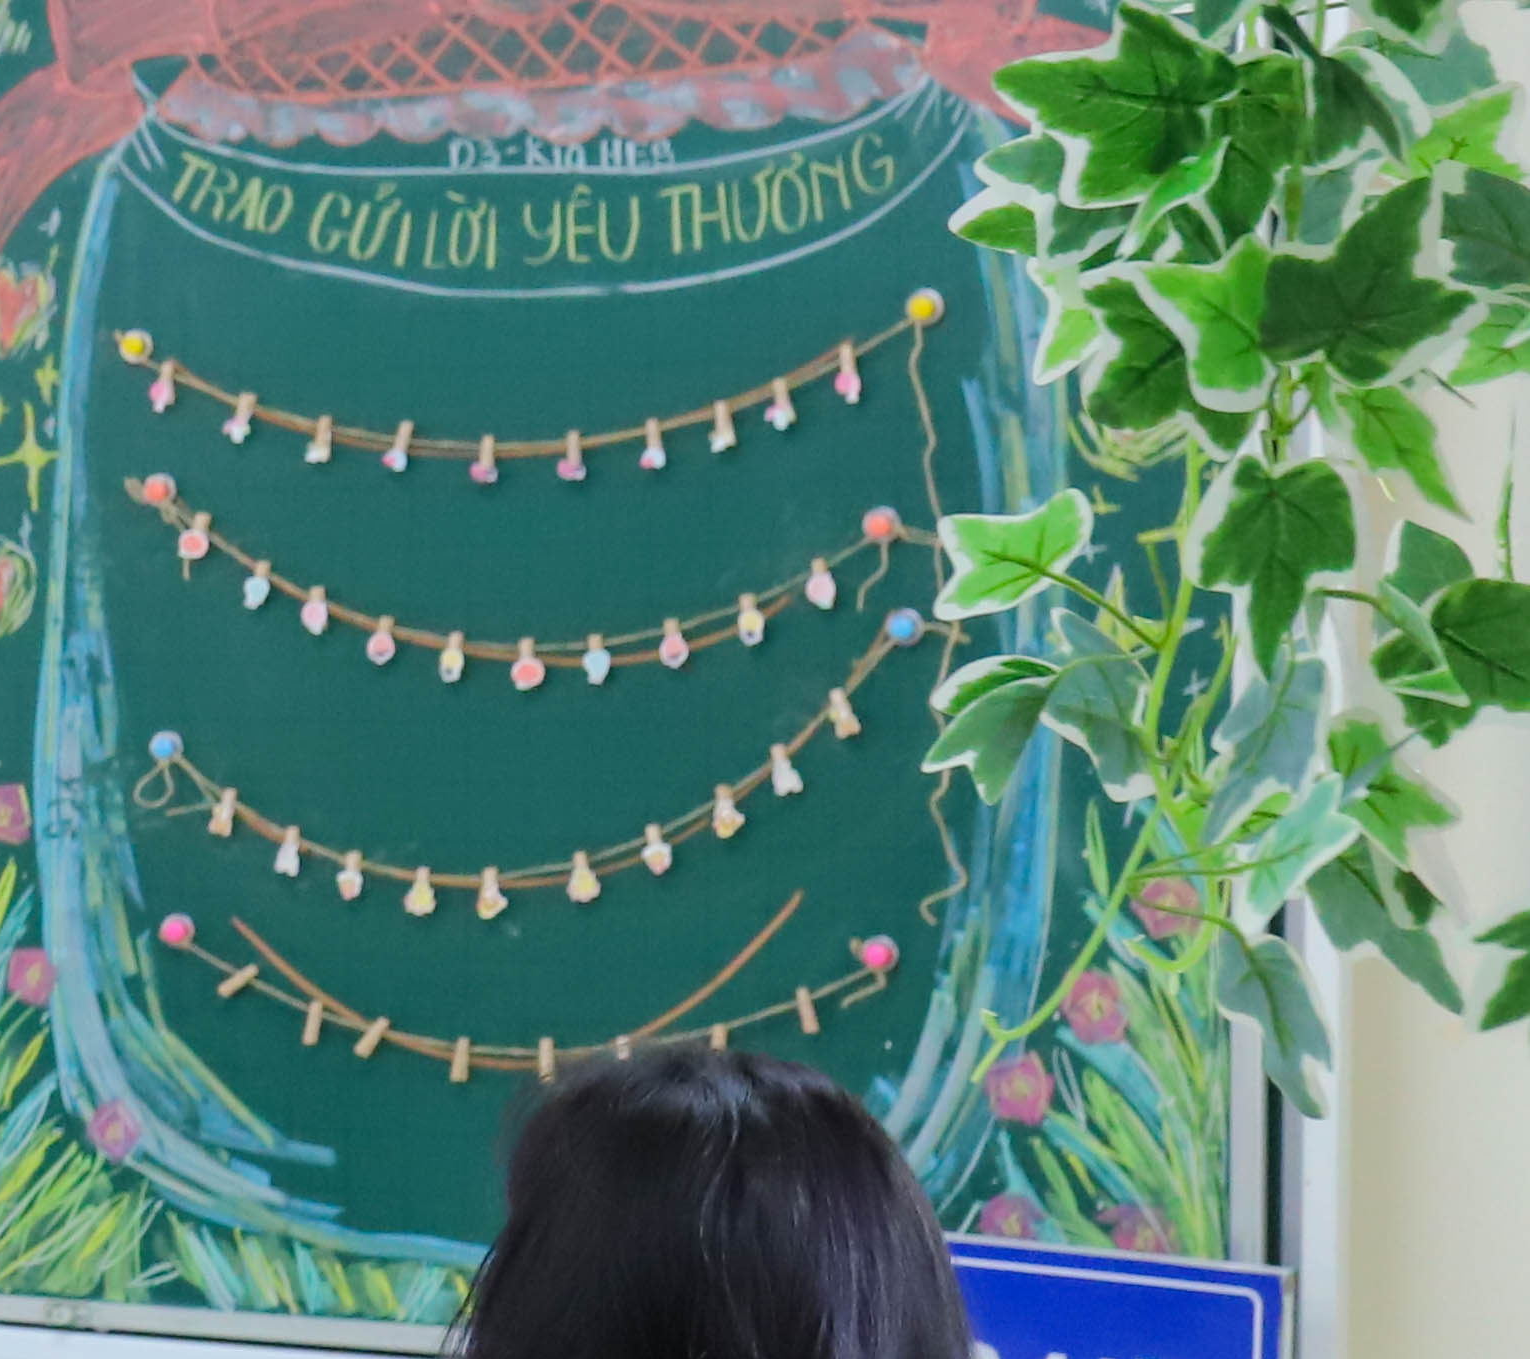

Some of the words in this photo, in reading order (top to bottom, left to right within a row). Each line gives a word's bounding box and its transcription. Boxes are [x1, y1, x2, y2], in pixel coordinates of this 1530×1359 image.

[171, 150, 294, 234] TRAO
[423, 190, 498, 270] LỜI
[523, 184, 641, 265] YÊU
[659, 133, 895, 256] THƯƠNG
